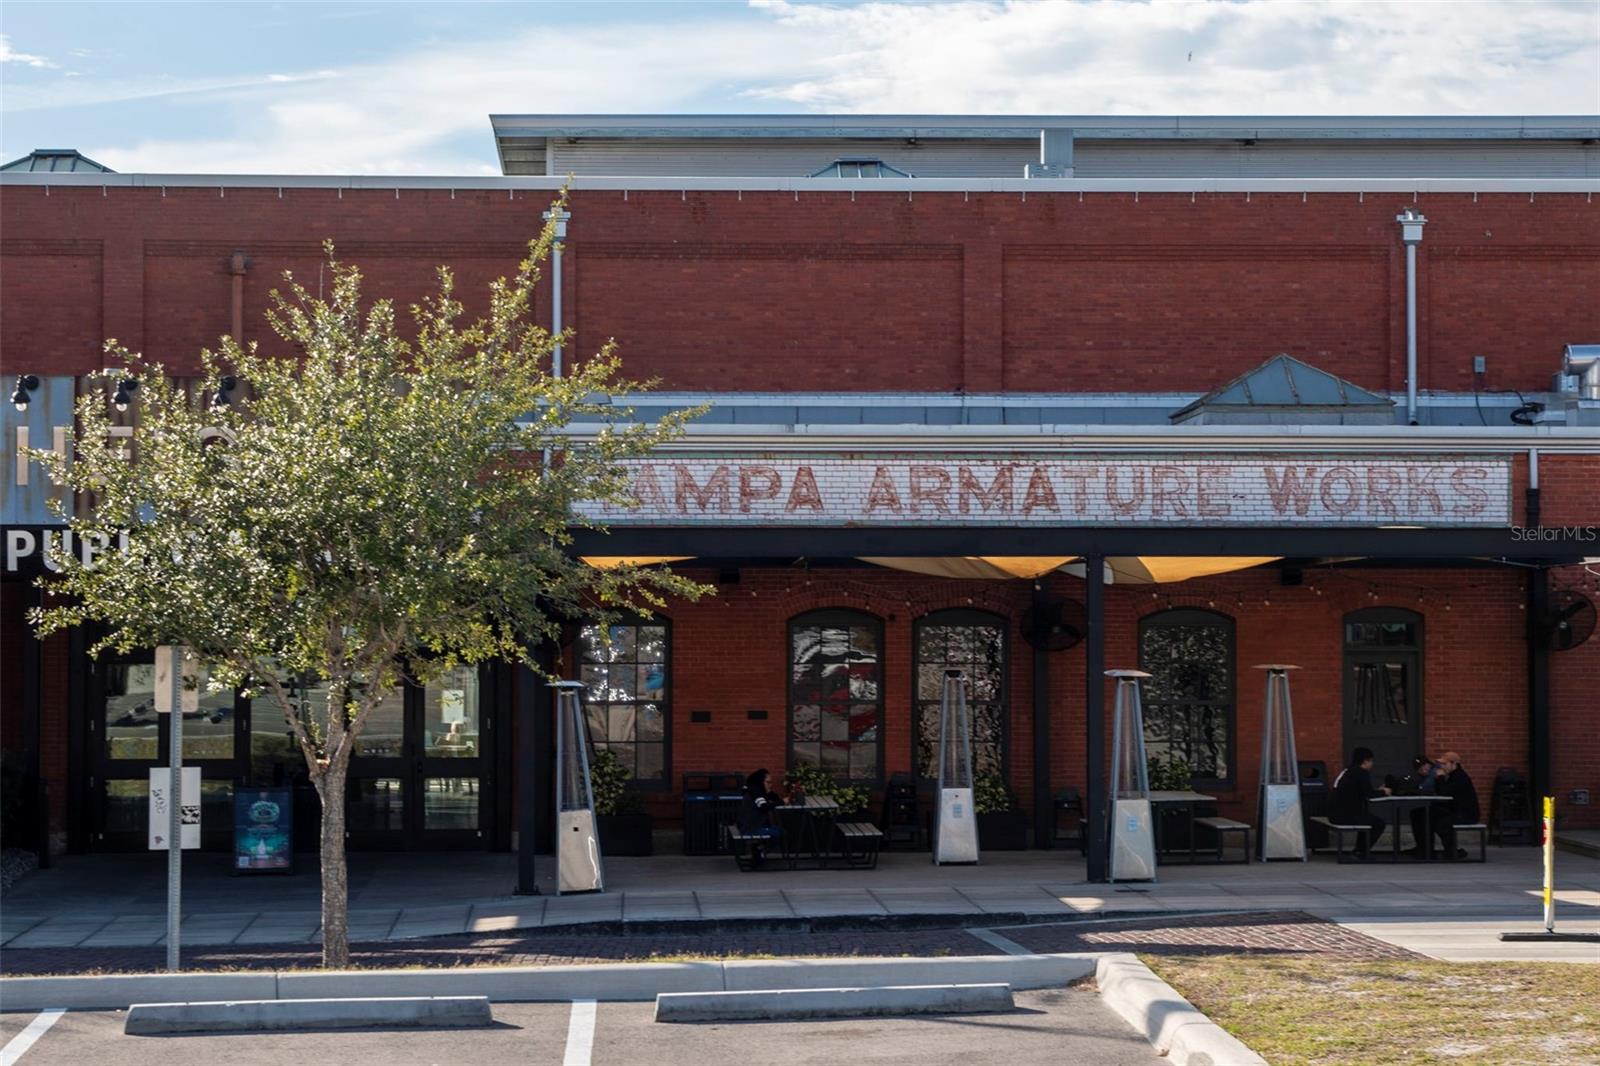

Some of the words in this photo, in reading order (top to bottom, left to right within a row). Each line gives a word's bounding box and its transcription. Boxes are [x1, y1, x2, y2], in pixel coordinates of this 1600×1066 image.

[602, 464, 825, 514] AMPA
[866, 464, 1232, 518] ARMATURE
[1264, 464, 1489, 517] WORKS
